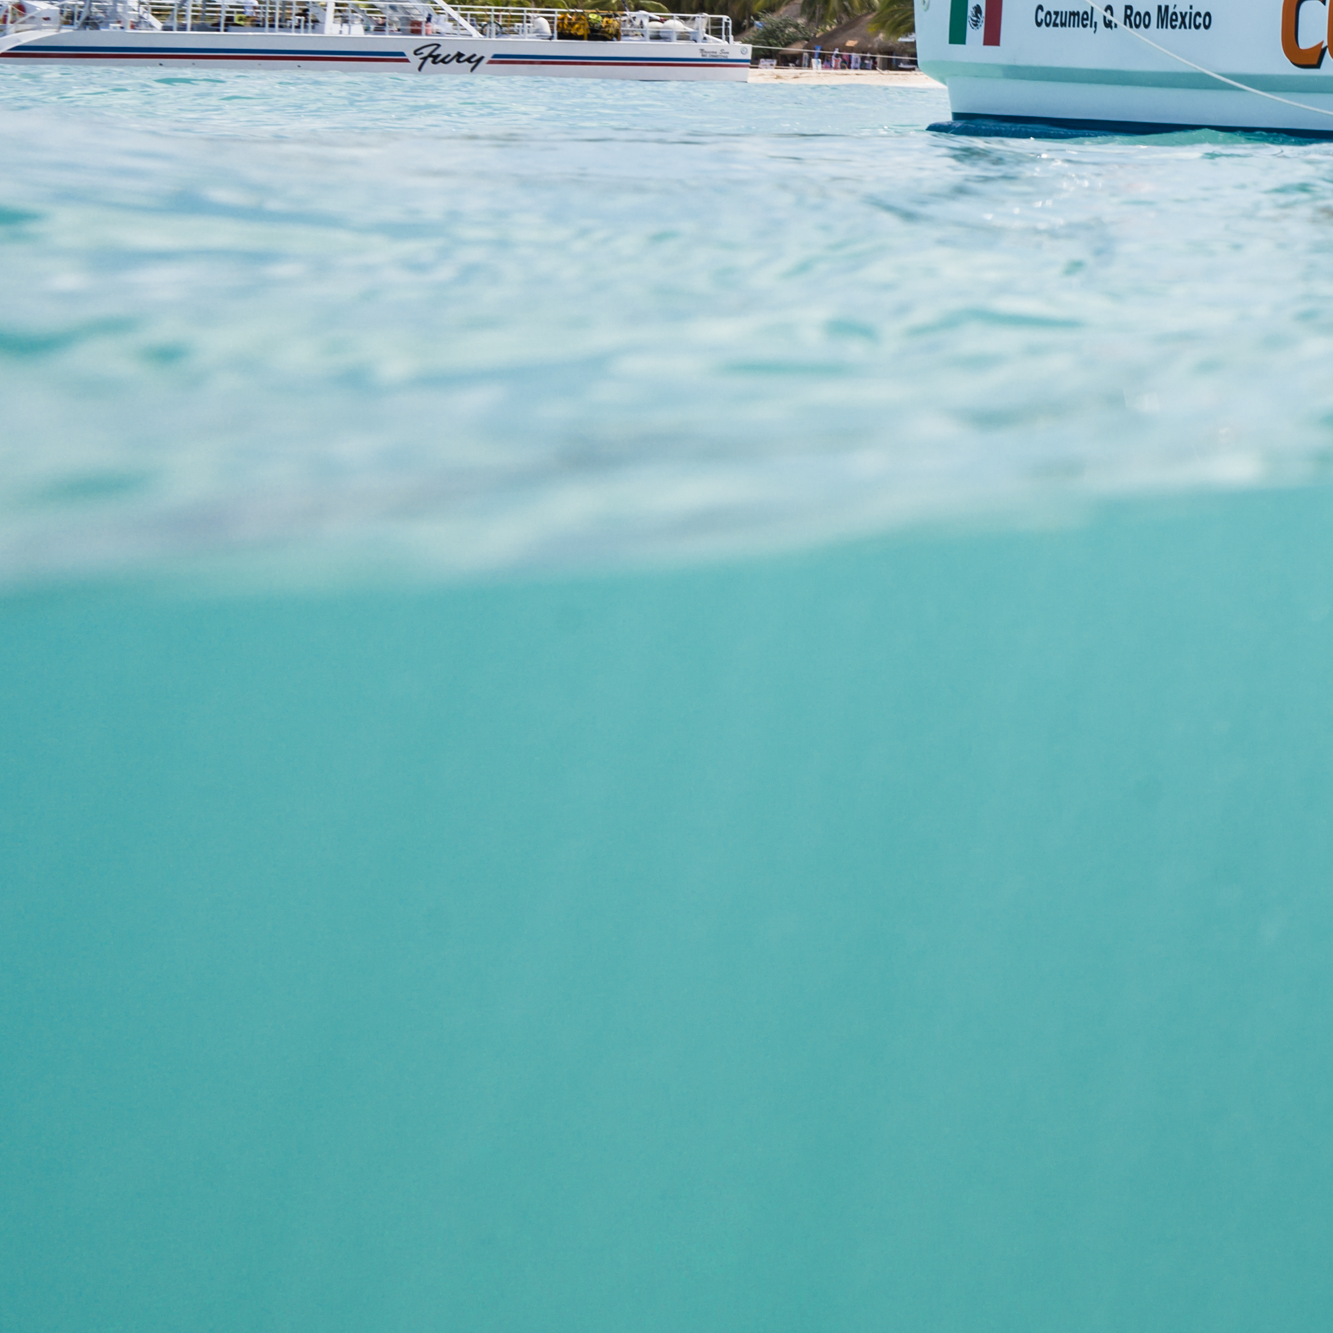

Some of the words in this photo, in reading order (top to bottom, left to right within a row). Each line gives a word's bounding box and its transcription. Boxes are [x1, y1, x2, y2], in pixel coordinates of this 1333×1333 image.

[1034, 4, 1097, 34] Cozumel,
[1103, 4, 1118, 31] Q.
[1123, 4, 1151, 30] Roo
[1156, 4, 1212, 30] México
[413, 43, 485, 72] Fury
